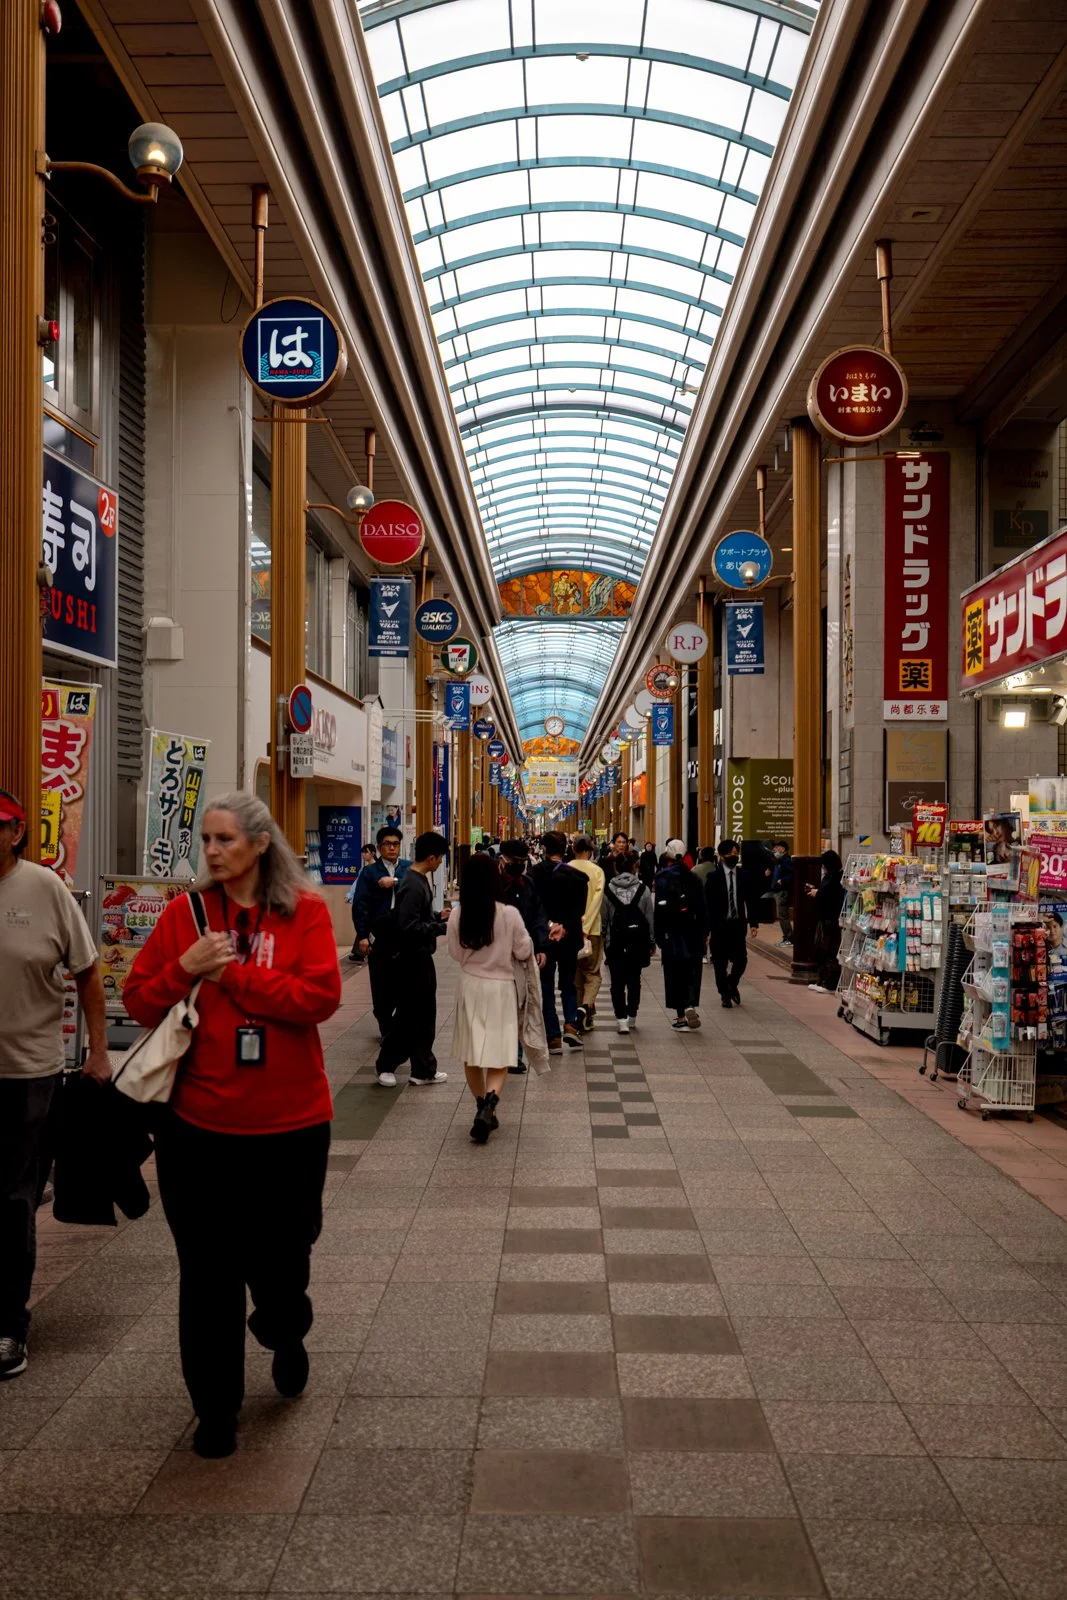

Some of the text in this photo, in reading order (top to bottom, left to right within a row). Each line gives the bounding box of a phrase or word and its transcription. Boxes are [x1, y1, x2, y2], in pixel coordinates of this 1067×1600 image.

[269, 326, 313, 368] は
[829, 383, 891, 402] いまい
[100, 492, 115, 528] 2F
[363, 523, 419, 536] DAISO
[720, 548, 767, 556] サポートプラザ
[901, 461, 932, 652] サンドラッグ
[673, 636, 703, 650] R.P
[967, 607, 982, 668] 薬
[902, 661, 930, 689] 薬
[69, 695, 86, 711] は
[890, 704, 940, 715] 尚都乐客
[183, 772, 200, 827] 山盛り
